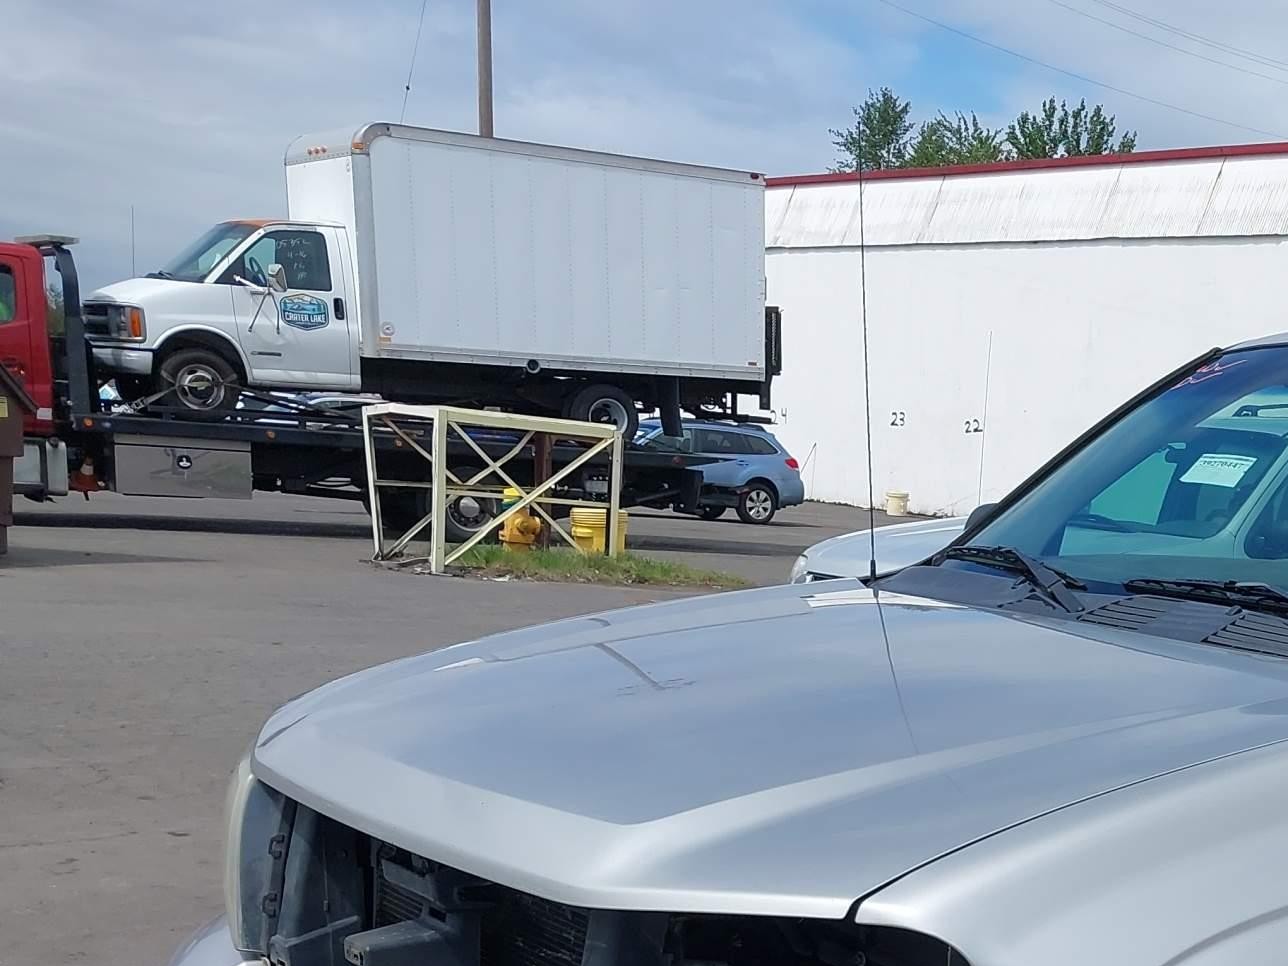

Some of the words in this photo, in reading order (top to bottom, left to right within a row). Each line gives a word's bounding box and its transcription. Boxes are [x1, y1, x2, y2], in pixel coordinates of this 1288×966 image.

[285, 311, 310, 322] CRATER
[310, 314, 326, 323] LAKE
[890, 411, 906, 427] 23
[964, 418, 983, 433] 22
